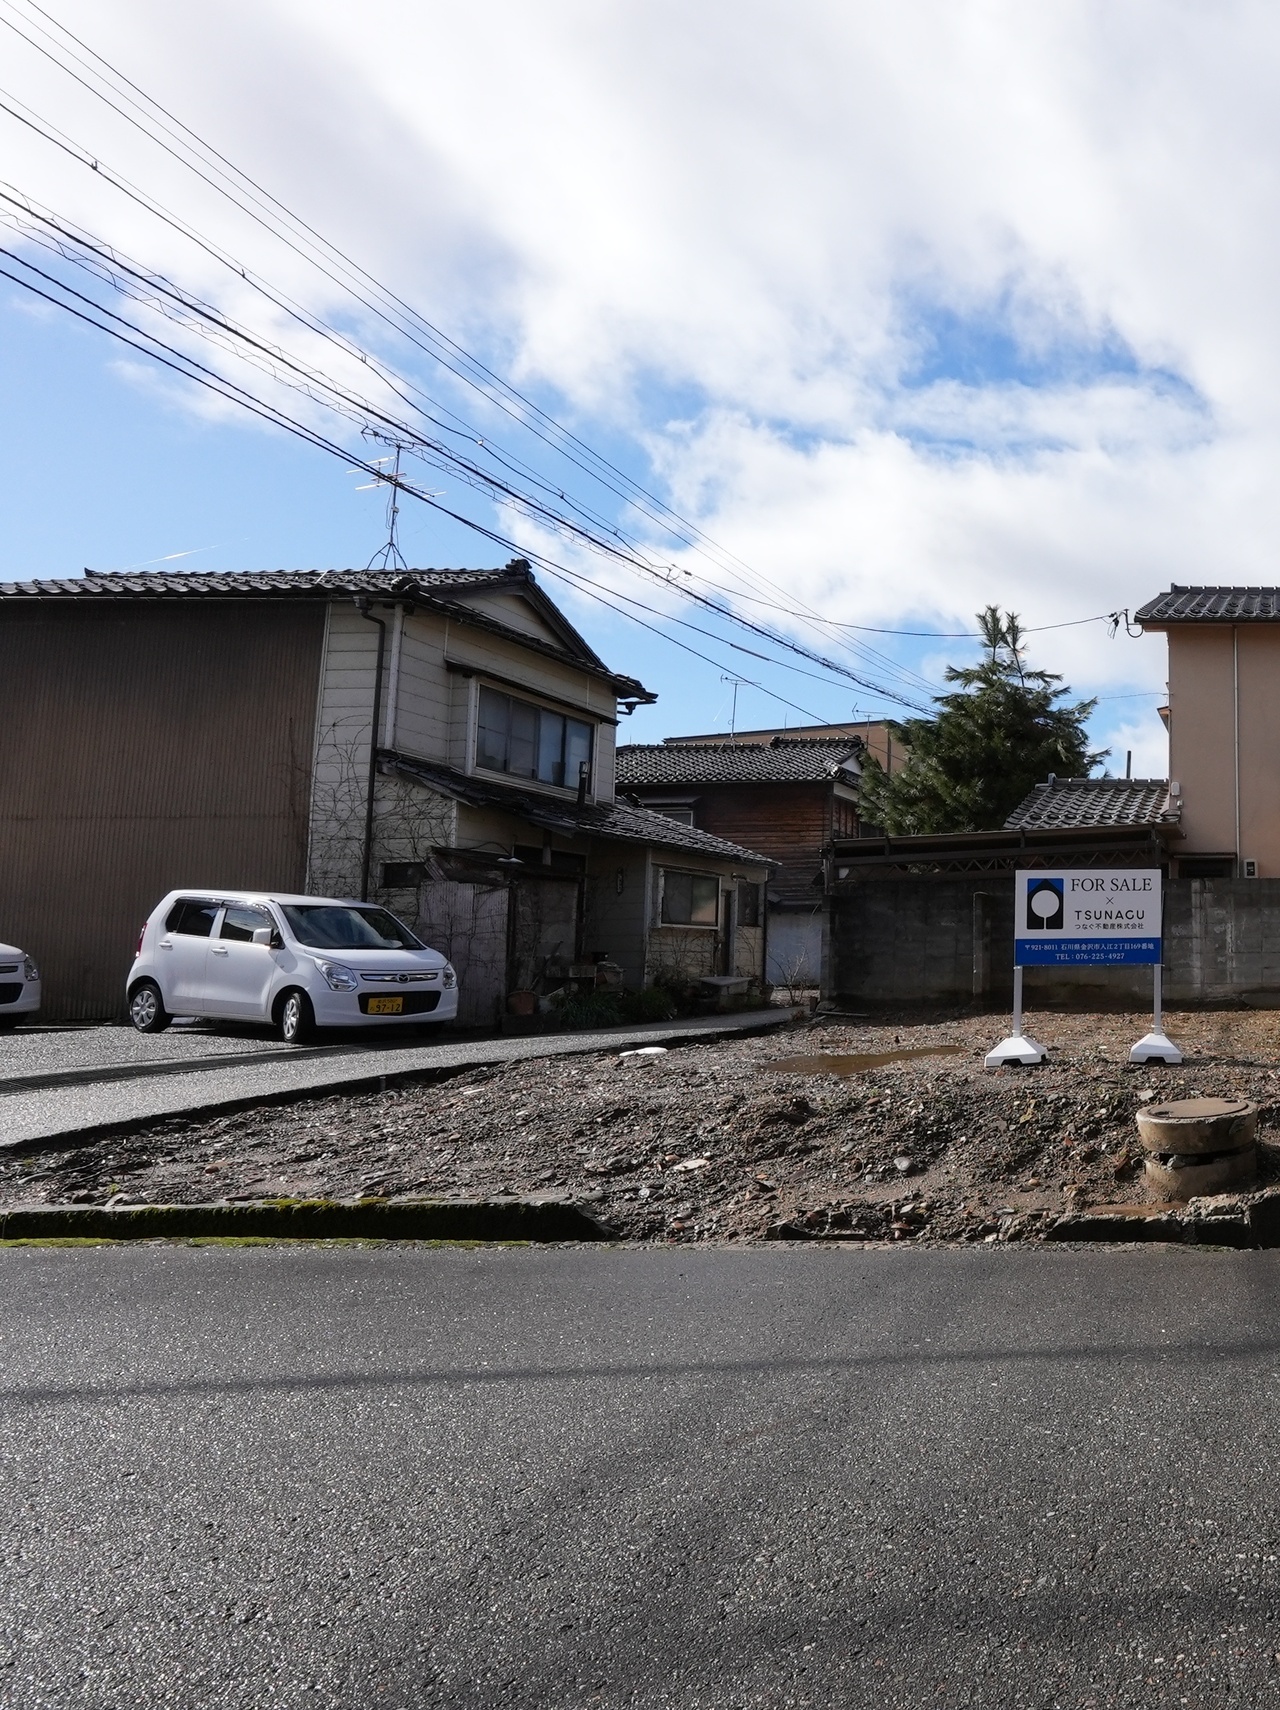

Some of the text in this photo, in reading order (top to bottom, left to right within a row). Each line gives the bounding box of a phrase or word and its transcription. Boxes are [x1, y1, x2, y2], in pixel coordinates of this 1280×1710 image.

[1071, 878, 1152, 892] FOR SALE
[1075, 910, 1145, 921] TSUNAGU
